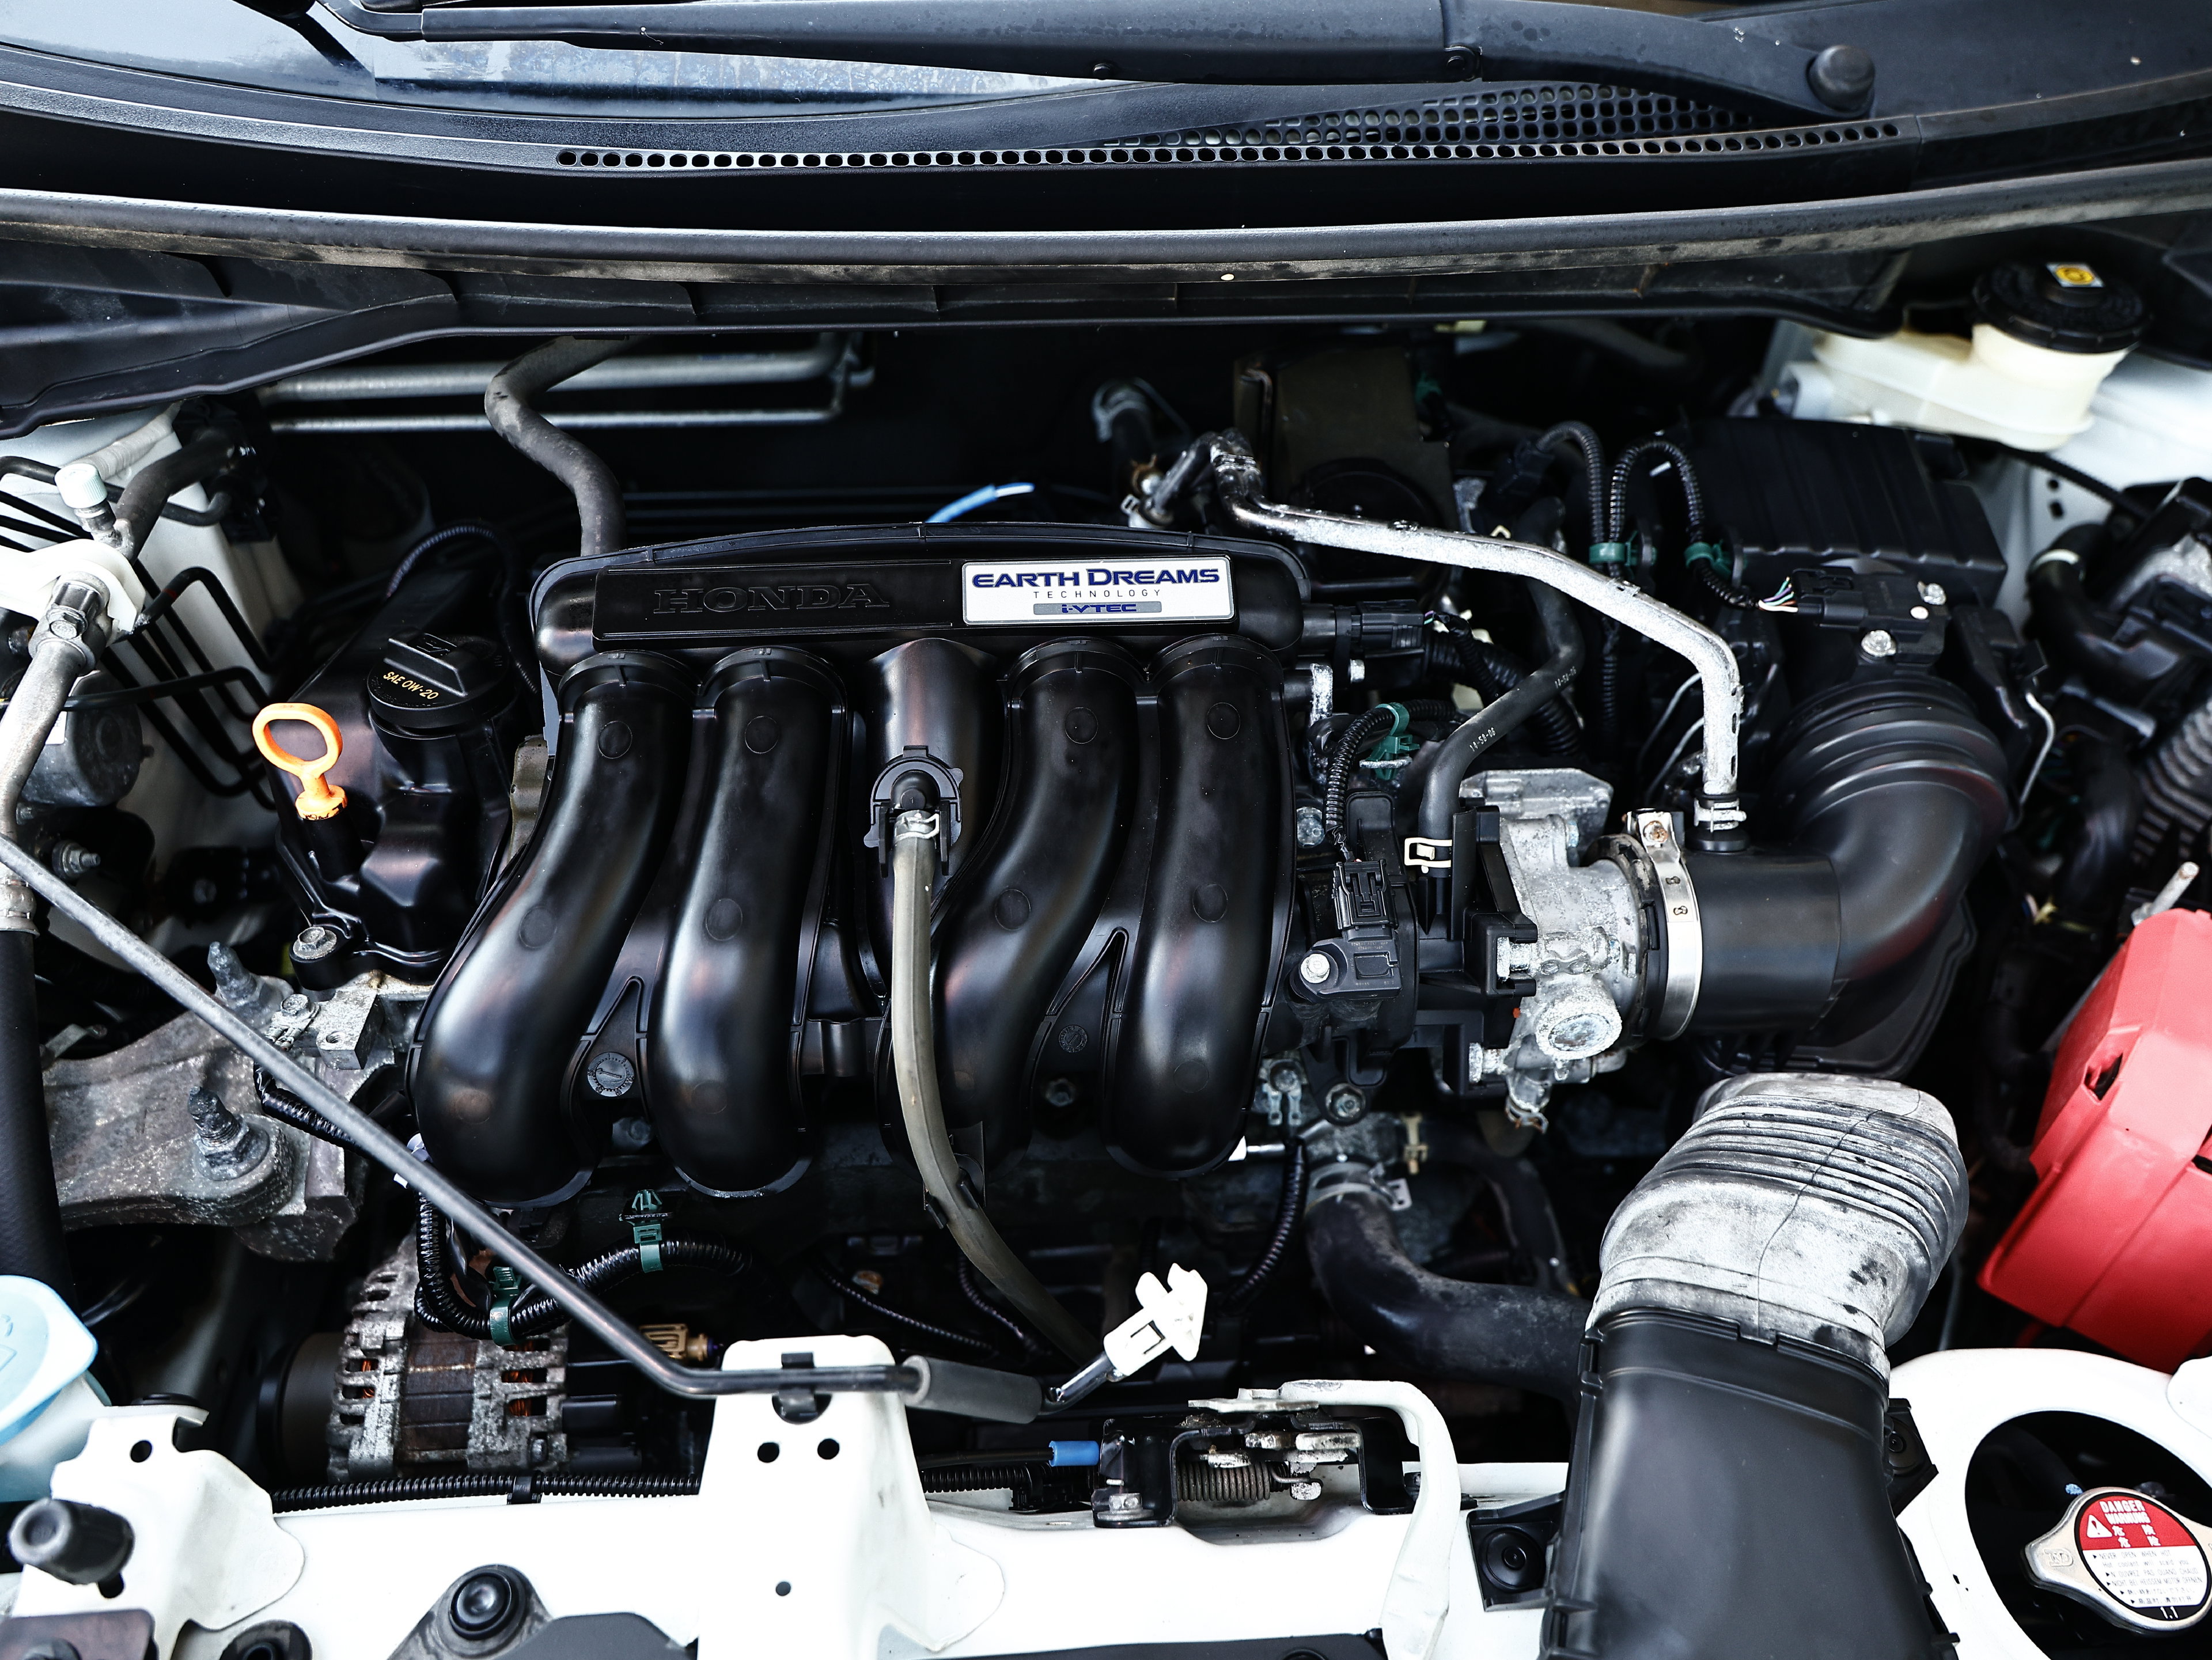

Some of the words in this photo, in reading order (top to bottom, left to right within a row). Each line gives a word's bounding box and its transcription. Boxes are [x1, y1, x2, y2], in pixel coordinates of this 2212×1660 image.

[972, 571, 1080, 588] EARTH
[1086, 568, 1220, 586] DREAMS
[653, 583, 890, 614] HONDA
[1033, 589, 1161, 599] TECHNOLOGY
[1062, 604, 1137, 613] i-VTEC
[383, 672, 406, 685] SAE
[2100, 1500, 2145, 1513] DANGER
[2104, 1511, 2152, 1525] WARNUNG
[2160, 1606, 2179, 1619] 1.1
